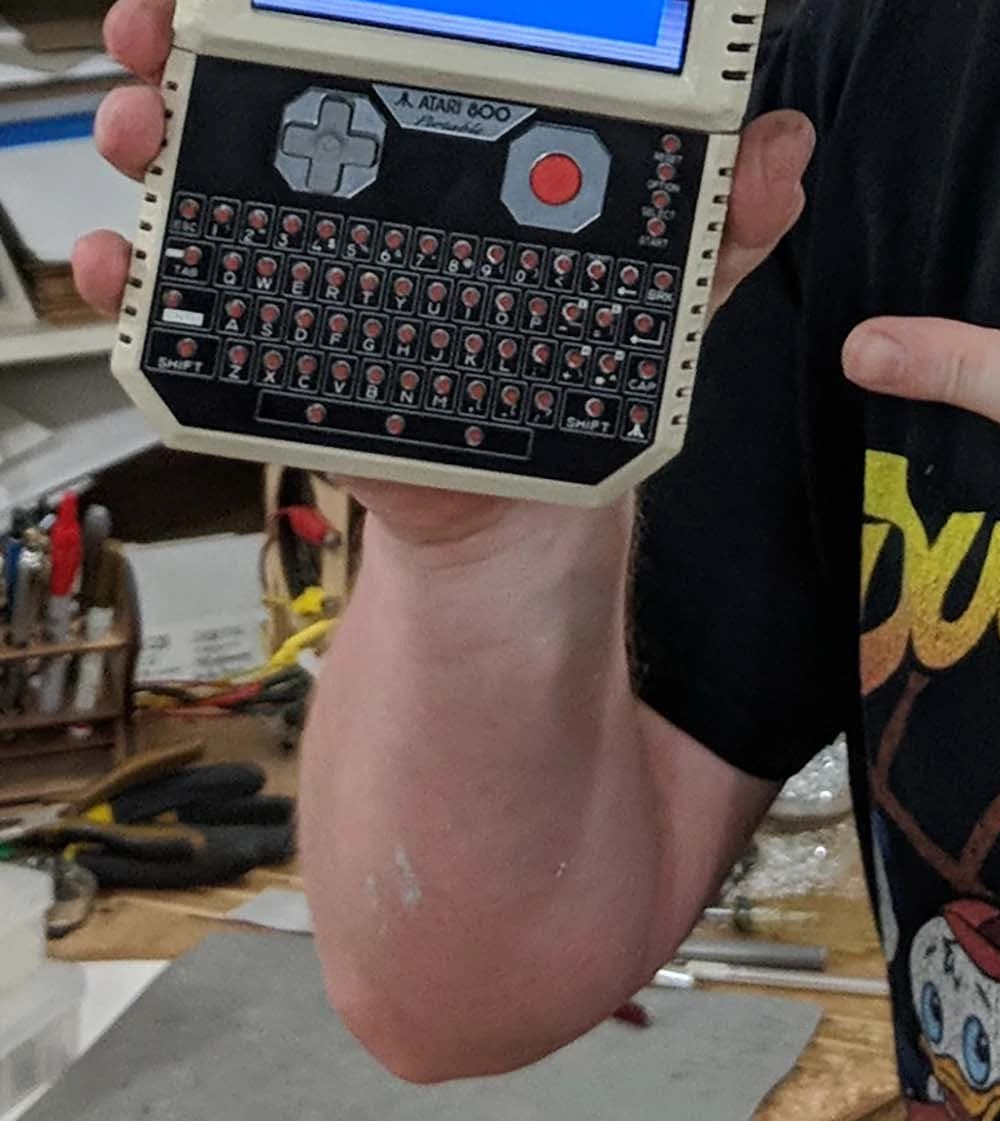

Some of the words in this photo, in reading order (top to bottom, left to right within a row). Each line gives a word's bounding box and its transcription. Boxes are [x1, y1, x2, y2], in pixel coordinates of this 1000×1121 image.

[418, 94, 463, 115] ATARI
[467, 100, 511, 122] 800
[243, 228, 255, 242] 2
[380, 249, 391, 263] 6
[481, 264, 492, 277] 9
[223, 271, 237, 285] Q
[256, 276, 273, 290] W
[291, 281, 304, 295] E
[325, 286, 340, 300] R
[362, 290, 374, 305] T
[395, 296, 407, 310] Y
[427, 301, 441, 315] U
[529, 316, 542, 329] P
[224, 318, 239, 331] A
[260, 323, 273, 337] S
[294, 328, 308, 342] D
[329, 332, 342, 345] F
[362, 338, 375, 352] G
[396, 344, 411, 357] H
[430, 349, 444, 361] J
[464, 354, 477, 367] K
[499, 359, 511, 372] L
[157, 356, 203, 373] SHIFT
[228, 364, 242, 379] Z
[264, 370, 277, 384] X
[298, 375, 311, 389] C
[334, 381, 346, 394] V
[365, 384, 378, 399] B
[399, 391, 414, 404] N
[431, 395, 448, 409] M
[566, 416, 611, 433] SHIFT
